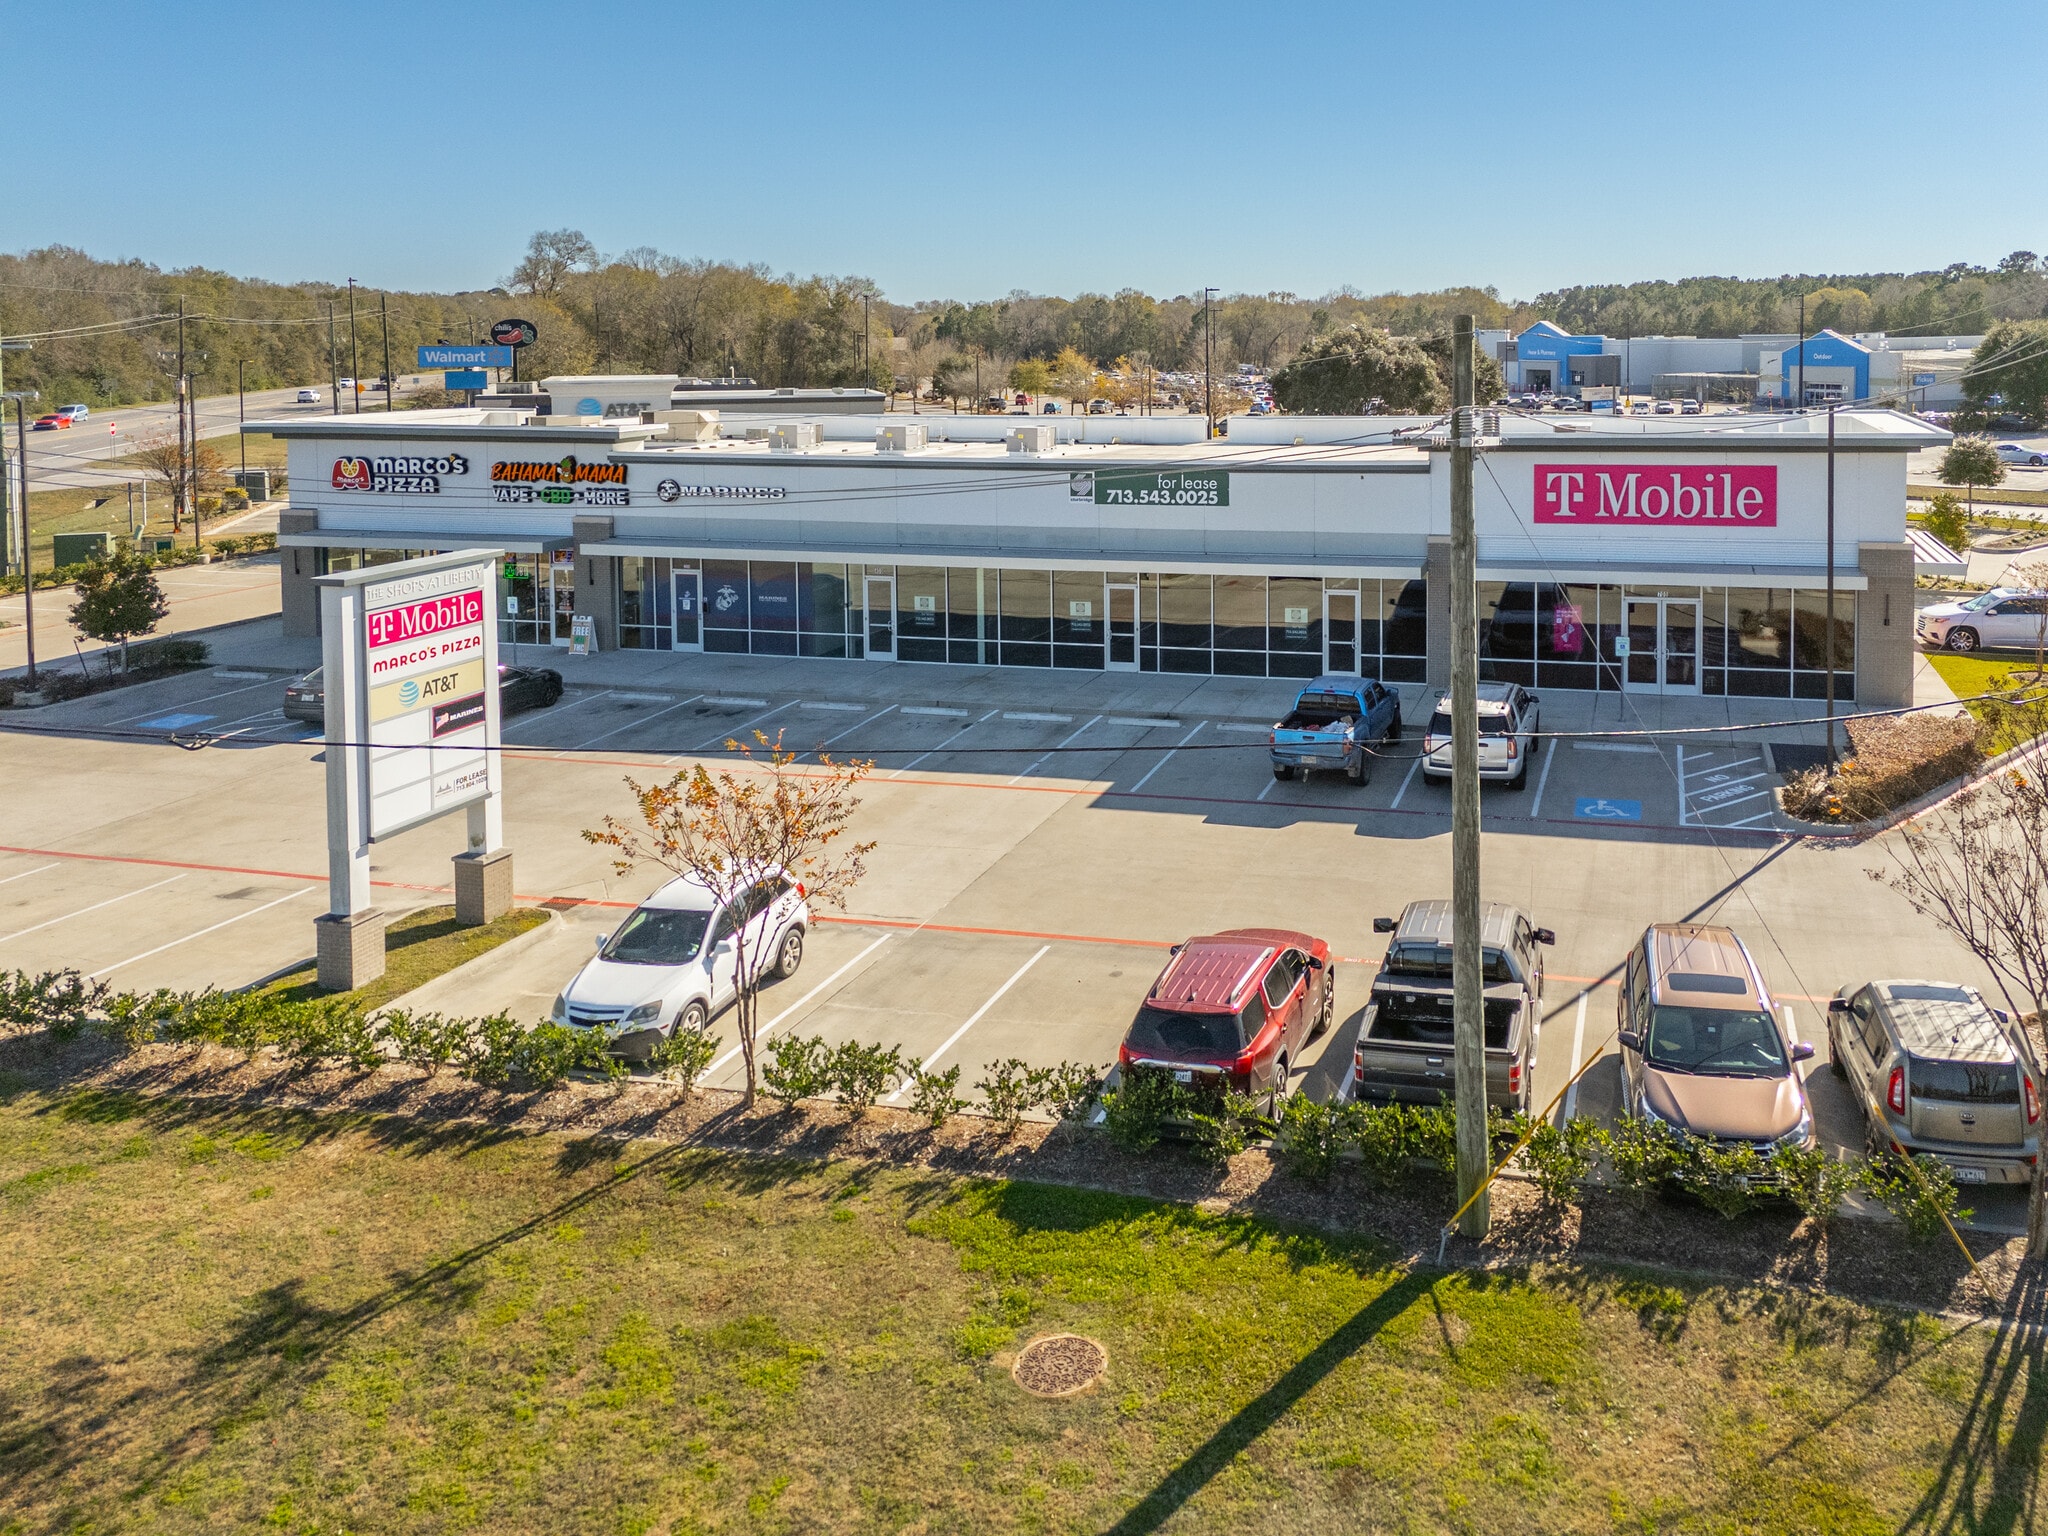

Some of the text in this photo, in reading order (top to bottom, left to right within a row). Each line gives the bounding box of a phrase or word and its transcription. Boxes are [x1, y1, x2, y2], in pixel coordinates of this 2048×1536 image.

[425, 351, 486, 363] Walmart
[1916, 376, 1934, 384] Pickup
[373, 456, 465, 474] MARCO'S
[491, 463, 624, 482] BAHAMA MAMA
[374, 477, 435, 493] PIZZA
[1158, 474, 1218, 489] for lease
[493, 488, 626, 505] VAPE CBD MORE
[680, 486, 784, 499] MARINES
[1106, 489, 1218, 504] 713.543.0025
[1595, 473, 1763, 519] Mobile
[367, 567, 482, 600] THE SHOPS AT LIBERTY
[398, 595, 480, 639] Mobile
[373, 636, 480, 673] MARCO'S PIZZA
[422, 673, 458, 698] AT&T
[450, 705, 484, 721] MARINES
[456, 775, 468, 785] FOR
[1704, 774, 1730, 783] NO
[1699, 785, 1755, 802] PARKING
